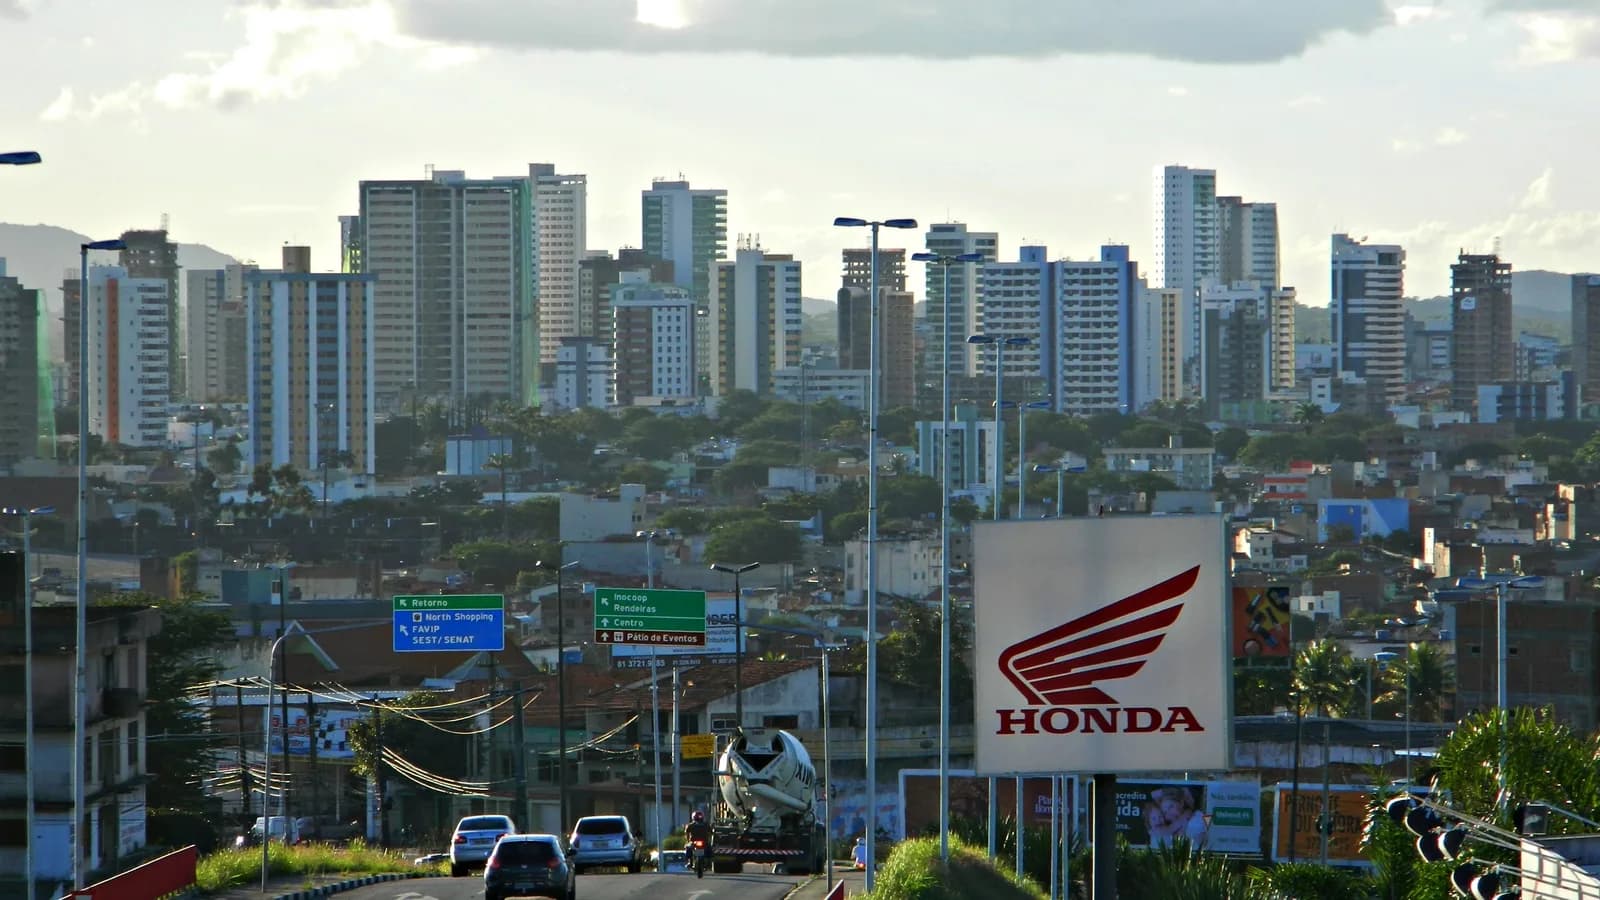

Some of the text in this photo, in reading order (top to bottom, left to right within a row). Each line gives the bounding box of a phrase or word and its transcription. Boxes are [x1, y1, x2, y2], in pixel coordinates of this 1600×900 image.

[614, 593, 648, 603] Inocoop
[412, 599, 448, 607] Retorno
[614, 604, 657, 613] Rendeiras
[425, 612, 494, 622] North Shopping
[613, 618, 644, 627] Centro
[412, 625, 440, 633] FAVIP
[627, 632, 698, 644] Pátio de Eventos
[995, 706, 1205, 735] HONDA
